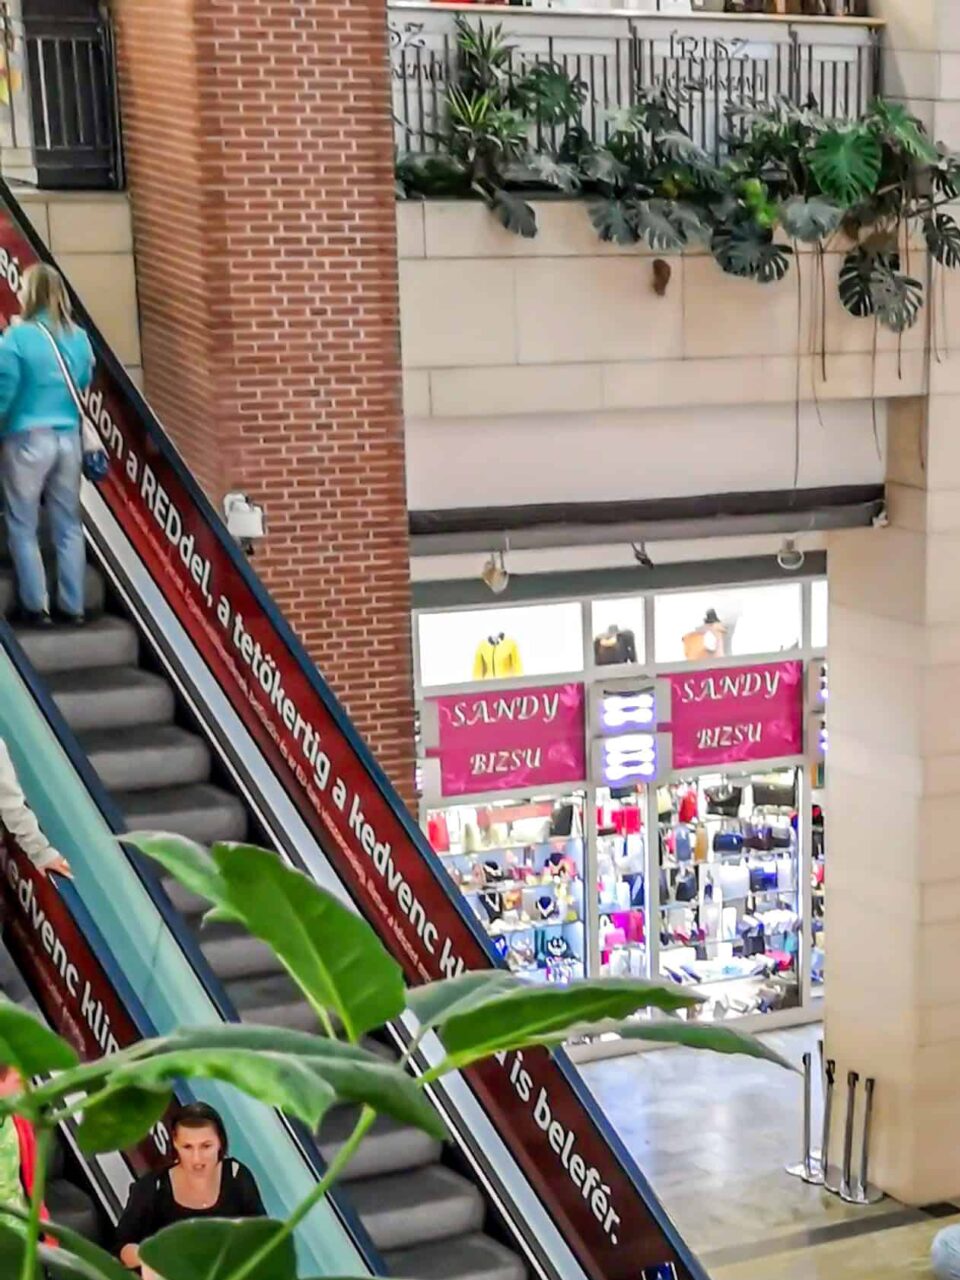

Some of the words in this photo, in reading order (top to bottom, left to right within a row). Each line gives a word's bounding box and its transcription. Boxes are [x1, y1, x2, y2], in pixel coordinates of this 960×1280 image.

[125, 452, 138, 483] a
[141, 468, 213, 608] REDdel,
[217, 594, 230, 628] a
[232, 613, 331, 791] tetőkertig
[332, 777, 348, 810] a
[349, 794, 439, 954] kedvenc
[681, 671, 780, 703] SANDY
[451, 693, 560, 727] SANDY
[698, 722, 762, 749] BIZSU
[470, 748, 542, 776] BIZSU
[510, 1051, 534, 1102] is
[533, 1087, 621, 1246] belefér.
